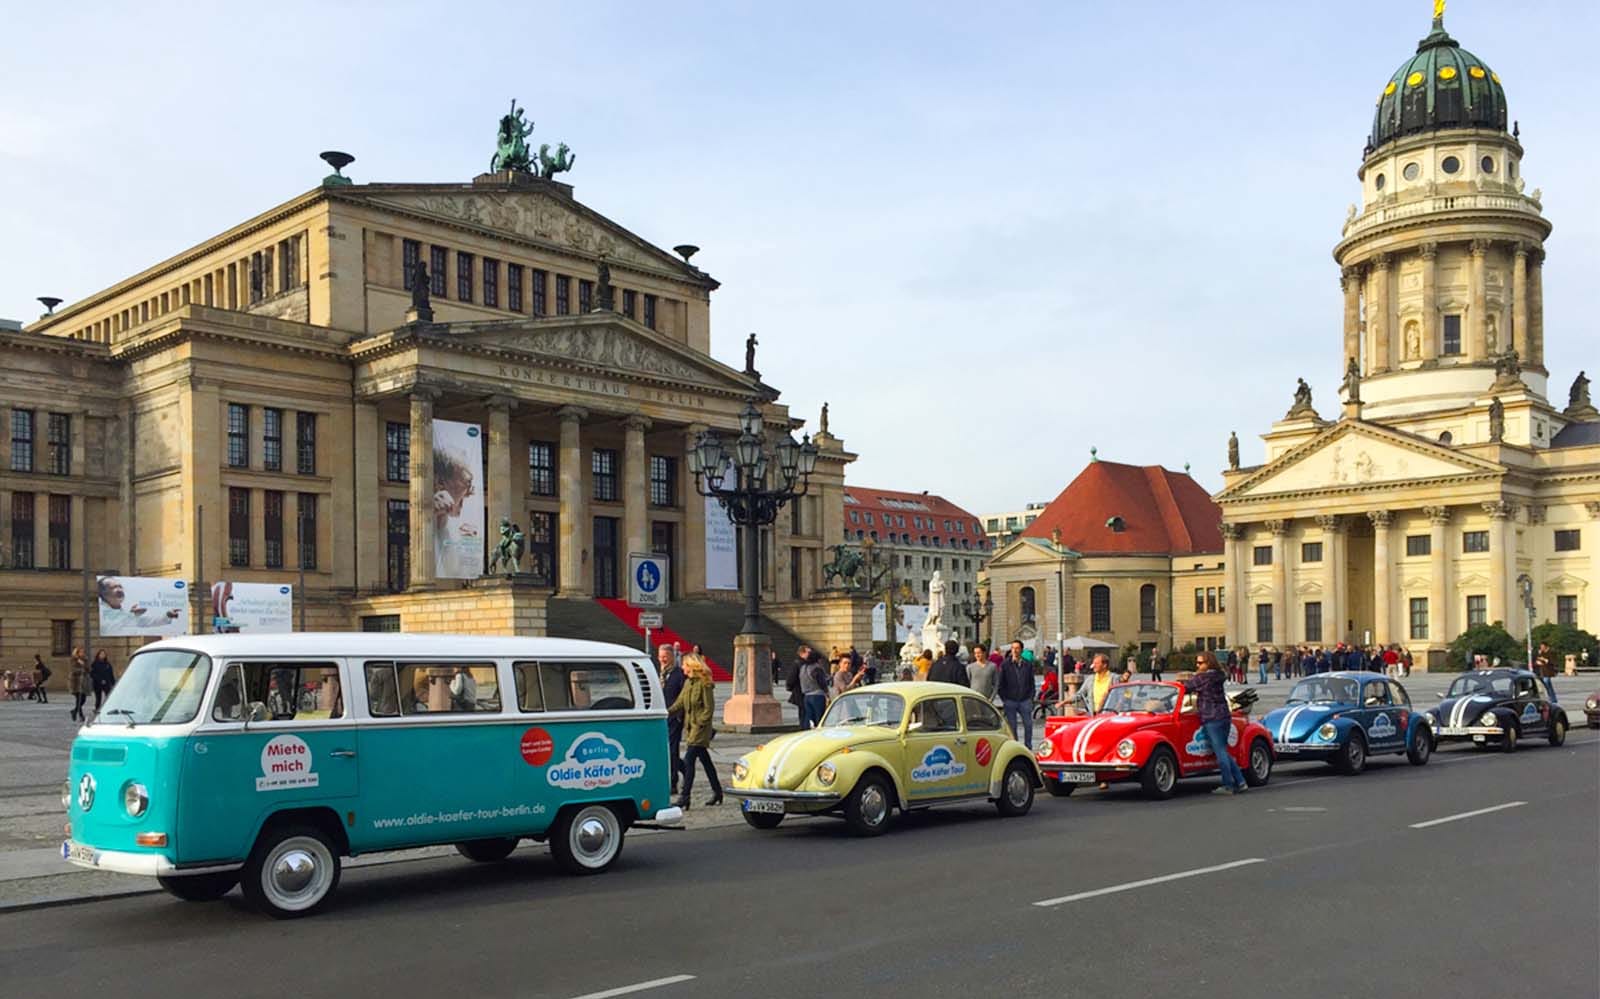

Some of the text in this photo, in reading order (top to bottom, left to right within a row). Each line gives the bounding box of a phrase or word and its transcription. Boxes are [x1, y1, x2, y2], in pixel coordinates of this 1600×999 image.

[500, 366, 705, 408] KONZERTHAUS BERLIN
[640, 593, 658, 603] ZONE
[267, 743, 306, 757] Miete
[582, 747, 609, 756] Berlin
[271, 759, 304, 773] mich
[550, 763, 642, 782] Oldie Käfer Tour
[912, 769, 931, 779] Oldie
[952, 765, 965, 773] Tour
[373, 803, 546, 829] www.oldie-kaefer-tour-berlin.de
